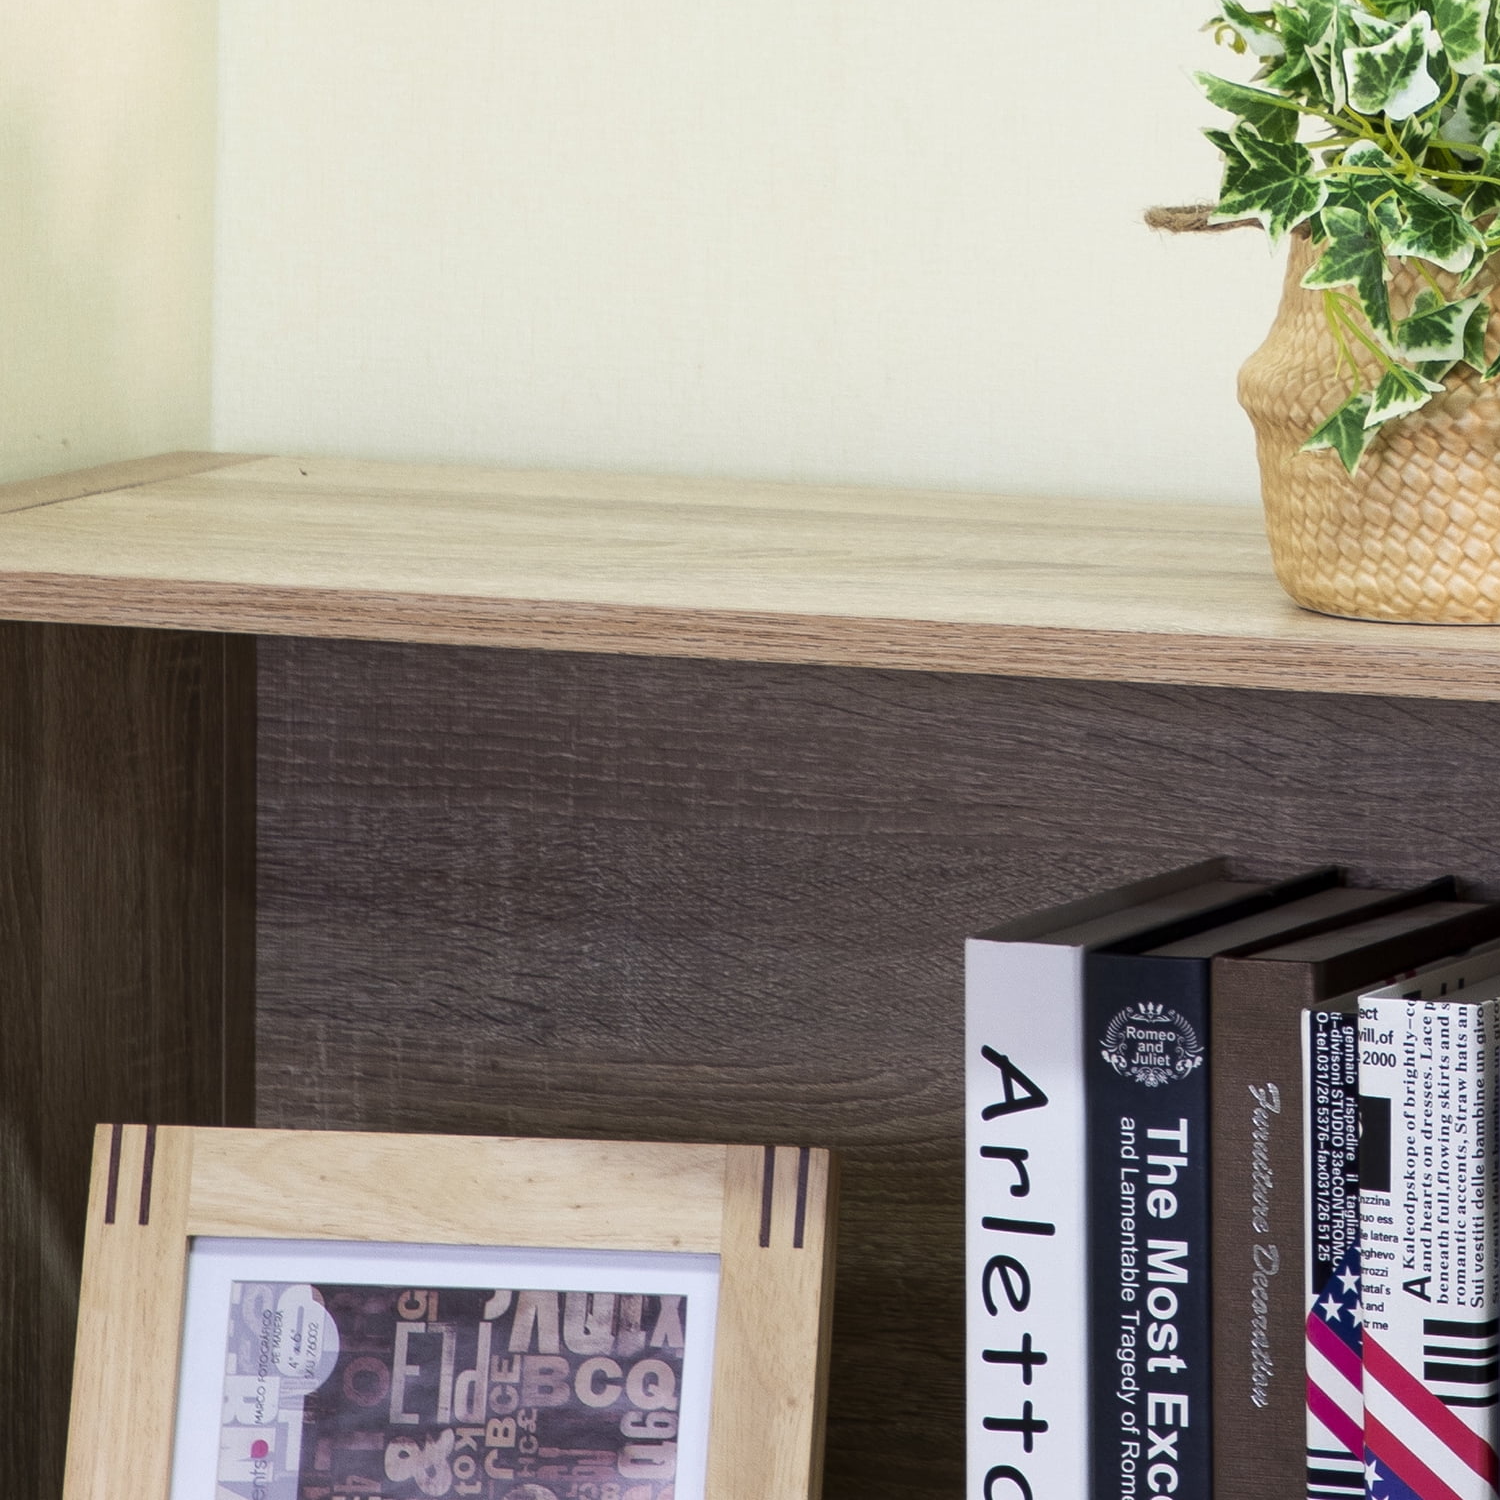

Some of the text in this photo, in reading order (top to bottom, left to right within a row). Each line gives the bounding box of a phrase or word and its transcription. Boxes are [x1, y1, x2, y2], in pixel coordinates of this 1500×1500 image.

[1126, 1026, 1176, 1042] Romeo
[1137, 1042, 1164, 1054] and
[1420, 1016, 1433, 1061] Lace
[1438, 1016, 1450, 1050] and
[1455, 1034, 1468, 1072] hats
[1131, 1052, 1171, 1067] Juliet
[1341, 1026, 1358, 1085] gennaio
[1363, 1051, 1396, 1067] 2000
[1475, 1050, 1486, 1073] un
[1420, 1066, 1433, 1140] dresses.
[1438, 1055, 1450, 1110] skirts
[1331, 1088, 1344, 1147] STUDIO
[1403, 1111, 1416, 1131] of
[1455, 1078, 1468, 1135] Straw
[1472, 1078, 1486, 1159] bambine
[1120, 1116, 1140, 1160] and
[1343, 1097, 1359, 1161] rispedire
[1346, 1174, 1359, 1182] il
[1423, 1146, 1433, 1168] on
[1455, 1140, 1470, 1215] accents,
[1402, 1136, 1418, 1270] Kaleodpskope
[1420, 1173, 1433, 1233] hearts
[1471, 1165, 1485, 1210] delle
[1120, 1167, 1141, 1303] Lamentable
[1248, 1082, 1281, 1409] Furniture Decoration
[1317, 1244, 1331, 1262] 25
[1318, 1224, 1331, 1240] 51
[1471, 1216, 1485, 1274] vestiti
[1420, 1238, 1433, 1273] and
[1437, 1229, 1449, 1304] beneath
[1454, 1220, 1467, 1306] romantic
[1146, 1117, 1190, 1500] The Most Exc
[1366, 1302, 1385, 1312] and
[1402, 1276, 1432, 1303] A
[1470, 1279, 1485, 1309] Sui
[1116, 1310, 1141, 1405] Tragedy
[254, 1385, 267, 1425] MARCO
[1120, 1411, 1141, 1436] of
